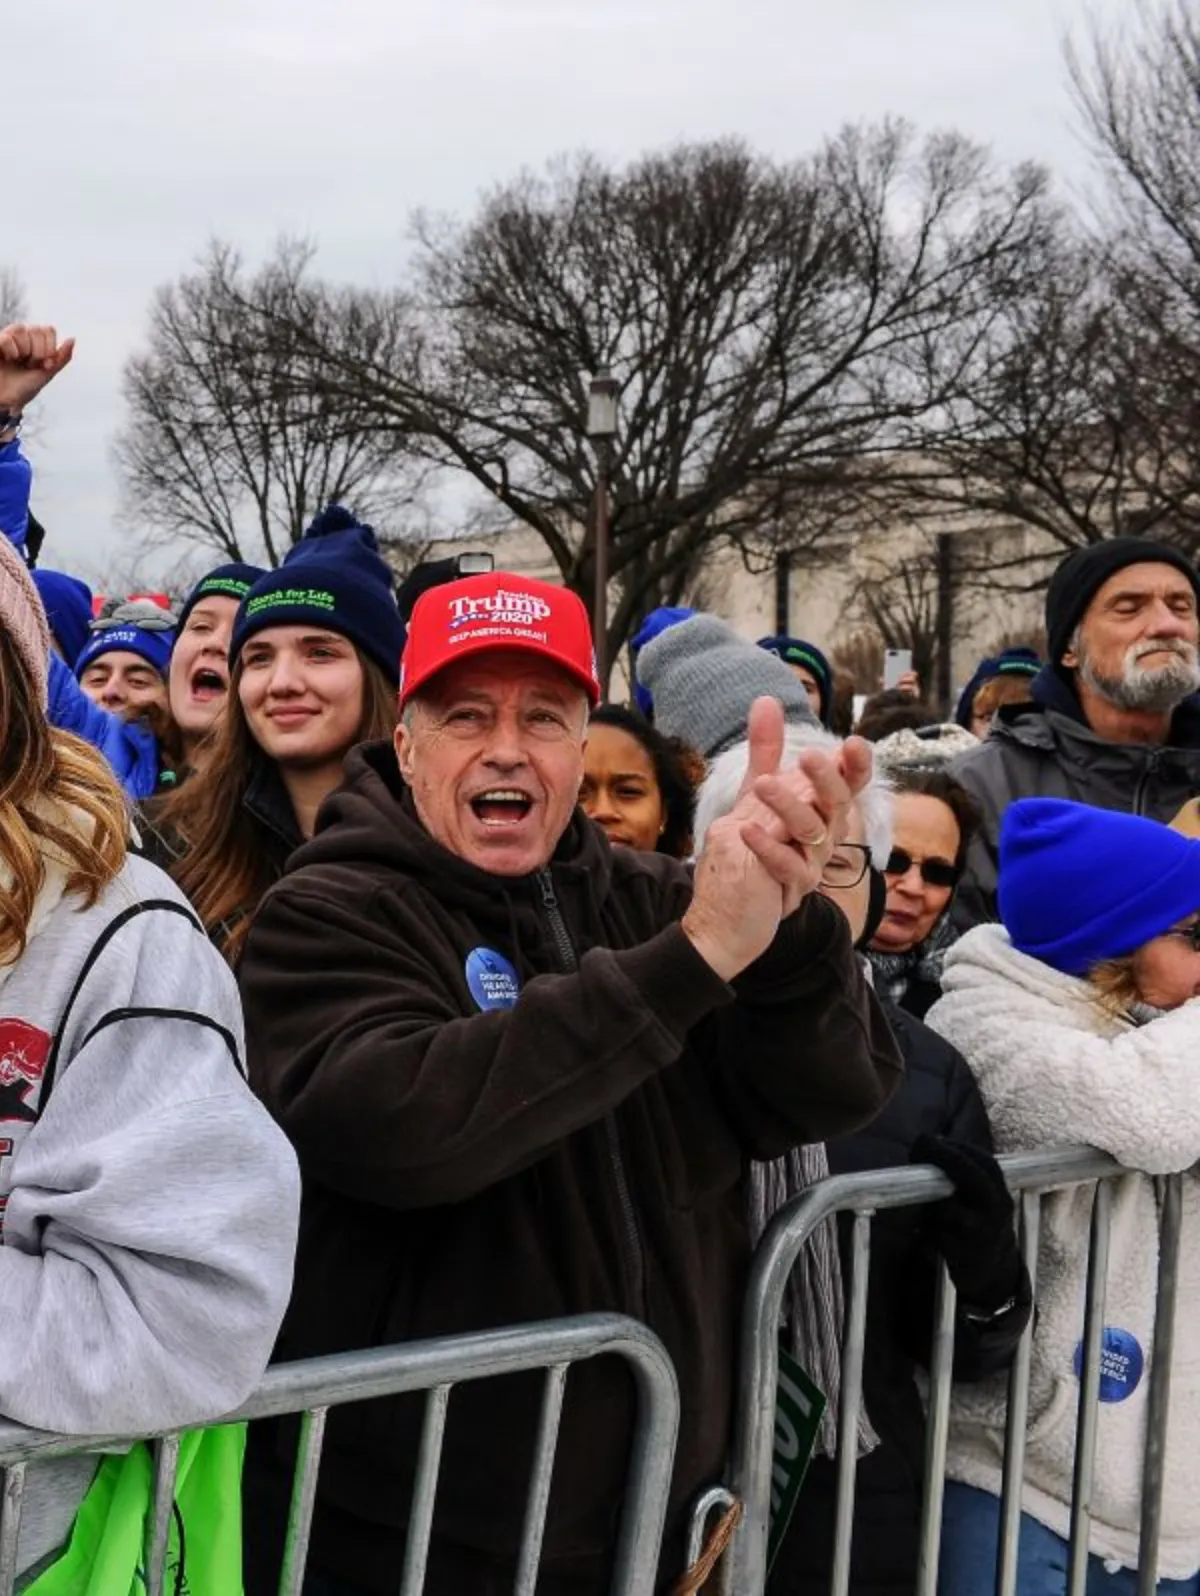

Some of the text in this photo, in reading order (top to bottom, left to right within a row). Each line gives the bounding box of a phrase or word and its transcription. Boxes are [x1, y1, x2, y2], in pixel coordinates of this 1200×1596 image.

[286, 589, 306, 600] for
[308, 589, 335, 603] Life
[448, 595, 551, 621] Trump
[490, 611, 532, 625] 2020
